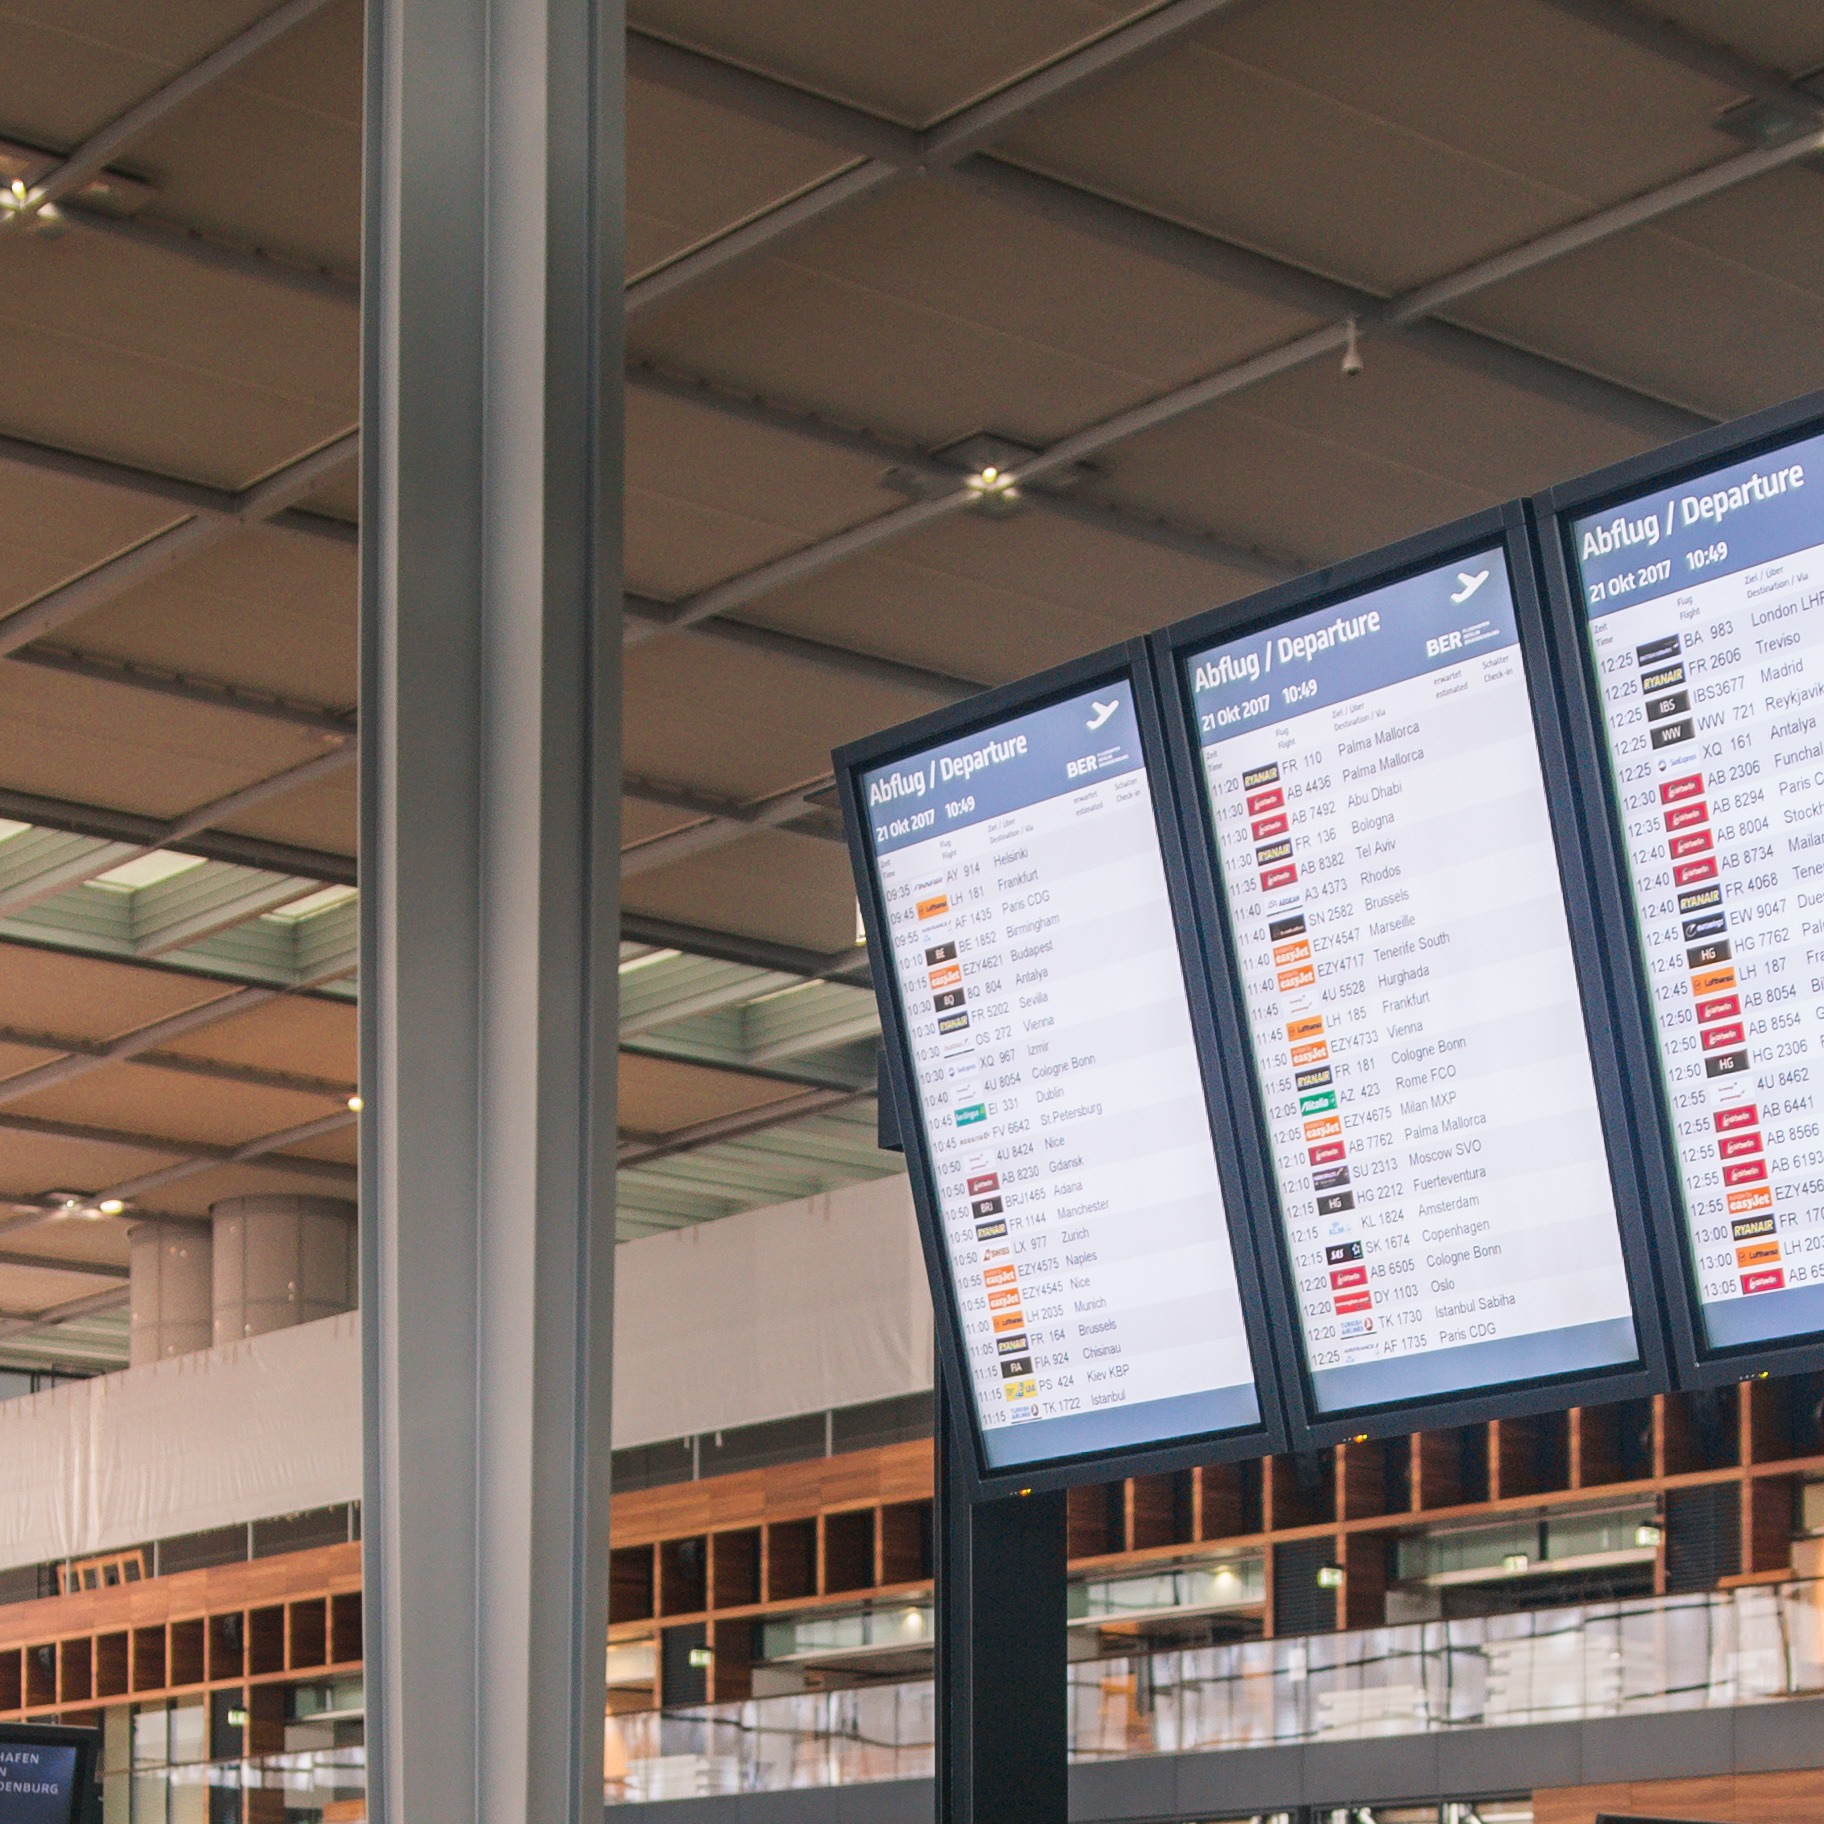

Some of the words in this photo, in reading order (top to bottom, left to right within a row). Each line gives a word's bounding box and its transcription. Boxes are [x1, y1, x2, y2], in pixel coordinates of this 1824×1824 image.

[1583, 515, 1659, 560] Abflug
[1666, 500, 1674, 535] /
[1681, 465, 1804, 525] Departure
[1589, 582, 1605, 602] 21
[1608, 573, 1636, 595] Okt
[1638, 559, 1670, 586] 2017
[1686, 541, 1727, 569] 10:49
[1195, 653, 1260, 692] Abflug
[1265, 641, 1271, 672] /
[1277, 611, 1380, 663] Departure
[1426, 631, 1462, 657] BER
[1603, 679, 1637, 703] 12:25
[1643, 668, 1682, 689] RYANAIR
[1688, 658, 1707, 675] FR
[1709, 647, 1741, 669] 2606
[1754, 632, 1800, 654] Treviso
[1201, 713, 1215, 731] 21
[1217, 705, 1241, 725] Okt
[1241, 694, 1269, 718] 2017
[1282, 679, 1317, 703] 10:49
[1607, 707, 1642, 728] 12:25
[1659, 698, 1675, 713] IBS
[1693, 675, 1744, 703] IBS3677
[1760, 658, 1803, 683] Madrid
[870, 771, 925, 806] Abflug
[929, 760, 935, 788] /
[940, 735, 1027, 780] Departure
[1066, 755, 1097, 778] BER
[1216, 802, 1243, 821] 11:30
[1287, 784, 1302, 800] AB
[1305, 774, 1331, 792] 4436
[1342, 764, 1376, 782] Palma
[1378, 748, 1424, 771] Mallorca
[876, 825, 888, 842] 21
[889, 818, 910, 836] Okt
[910, 808, 934, 830] 2017
[945, 796, 975, 818] 10:49
[902, 976, 927, 992] 10:15
[962, 954, 1002, 976] EZY4621
[1010, 939, 1053, 962] Budapest
[924, 1091, 948, 1106] 10:40
[984, 1079, 997, 1090] 4U
[999, 1072, 1021, 1088] 8054
[1031, 1061, 1069, 1079] Cologne
[1070, 1055, 1096, 1069] Bonn
[1682, 1144, 1714, 1162] 12:55
[1767, 1129, 1785, 1145] AB
[1788, 1122, 1819, 1141] 8566
[1285, 1201, 1314, 1220] 12:15
[1328, 1197, 1341, 1208] HG
[1356, 1188, 1374, 1203] HG
[1376, 1182, 1403, 1199] 2212
[1413, 1167, 1486, 1191] Fuerteventura
